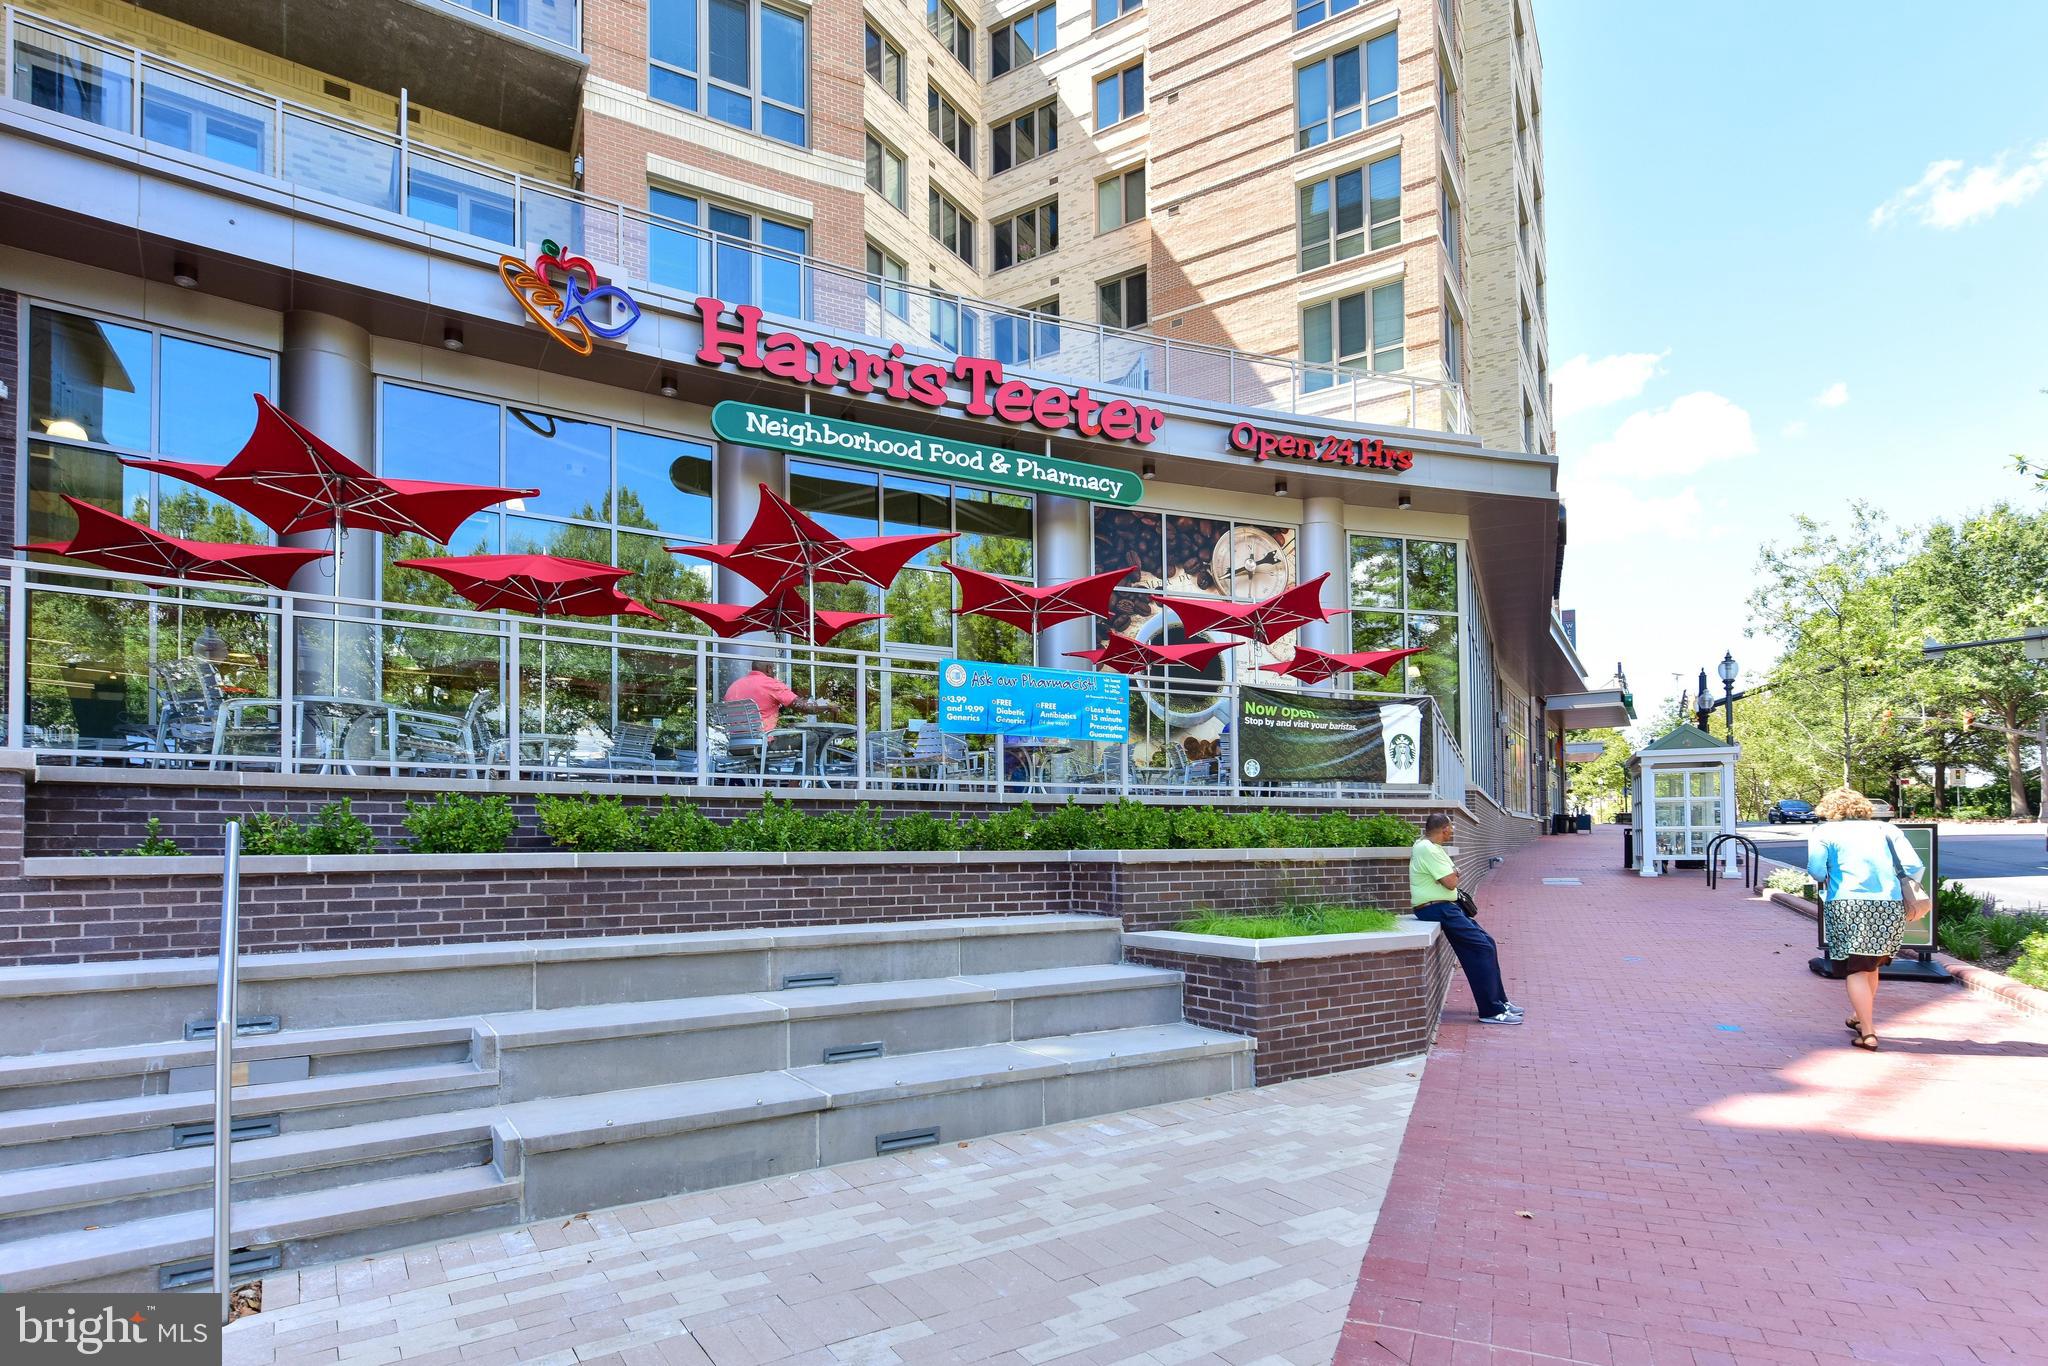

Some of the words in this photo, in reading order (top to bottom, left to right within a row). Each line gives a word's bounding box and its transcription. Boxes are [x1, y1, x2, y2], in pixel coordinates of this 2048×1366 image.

[694, 297, 949, 407] Harris
[953, 354, 1165, 445] Teeter
[1230, 422, 1317, 461] Open
[1318, 435, 1354, 465] 24
[1357, 438, 1413, 471] Hrs
[746, 411, 923, 462] Neighborhood
[928, 444, 984, 471] Food
[989, 452, 1011, 474] &
[1016, 458, 1123, 499] Pharmacy
[971, 672, 993, 687] Ask
[997, 676, 1018, 686] our
[1022, 673, 1098, 691] Pharmacist!
[997, 699, 1012, 707] FREE
[1041, 702, 1057, 710] FREE
[965, 705, 985, 713] $9.99
[996, 708, 1025, 716] Diabetic
[1090, 706, 1104, 714] Less
[1105, 707, 1121, 715] than
[1245, 701, 1277, 716] Now
[1281, 707, 1320, 719] open.
[947, 714, 980, 722] Generics
[996, 716, 1026, 724] Generics
[1040, 711, 1077, 720] Antibiotics
[1100, 715, 1123, 723] minute
[1090, 722, 1126, 732] Prescription
[1244, 716, 1263, 726] Stop
[1265, 718, 1274, 728] by
[1276, 719, 1291, 727] and
[1293, 719, 1309, 728] visit
[1311, 721, 1328, 730] your
[1329, 722, 1358, 731] baristas.
[1089, 731, 1123, 739] Guarantee
